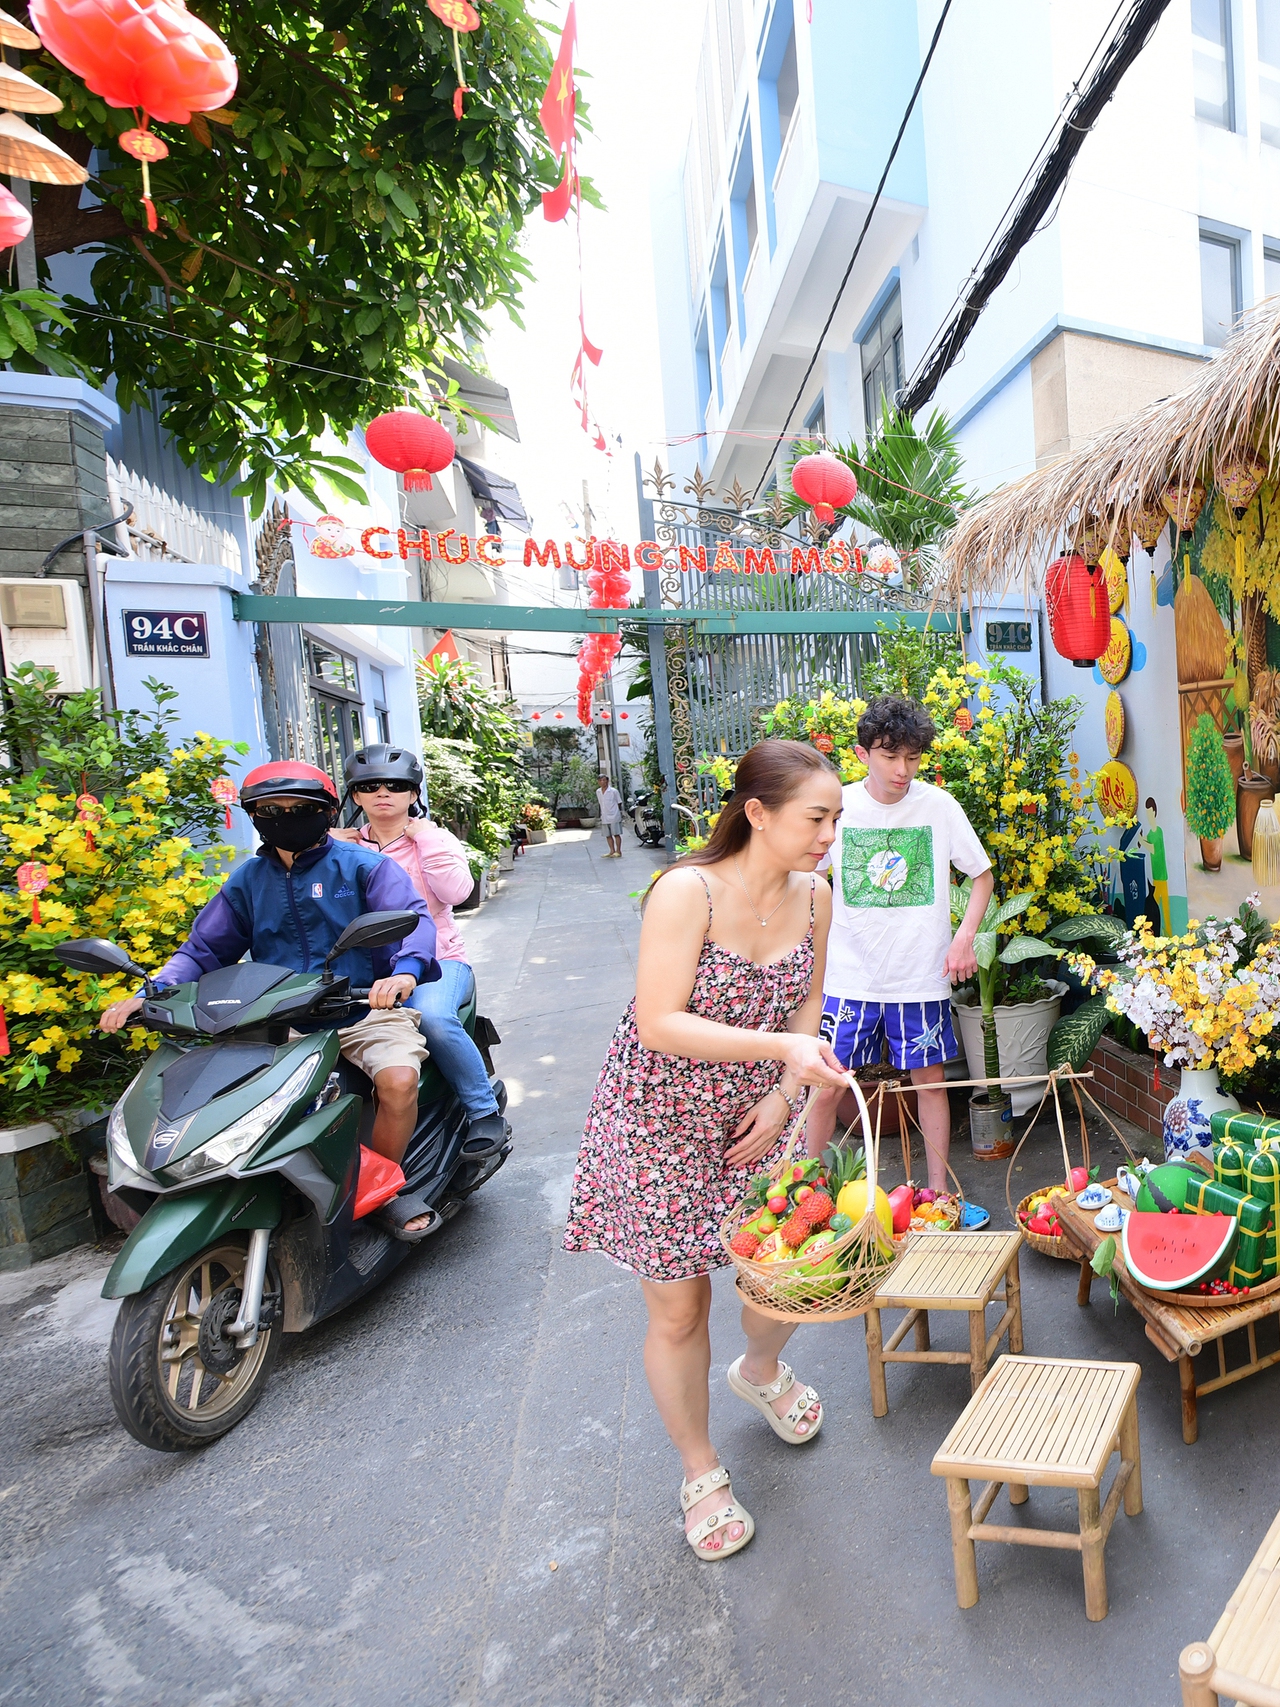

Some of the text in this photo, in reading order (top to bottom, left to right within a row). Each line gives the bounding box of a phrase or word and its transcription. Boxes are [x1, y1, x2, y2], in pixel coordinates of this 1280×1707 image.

[360, 526, 507, 567] CHÚC
[522, 535, 664, 573] MỪNG
[677, 540, 778, 576] NĂM
[131, 616, 200, 641] 94C
[988, 623, 1030, 644] 94C
